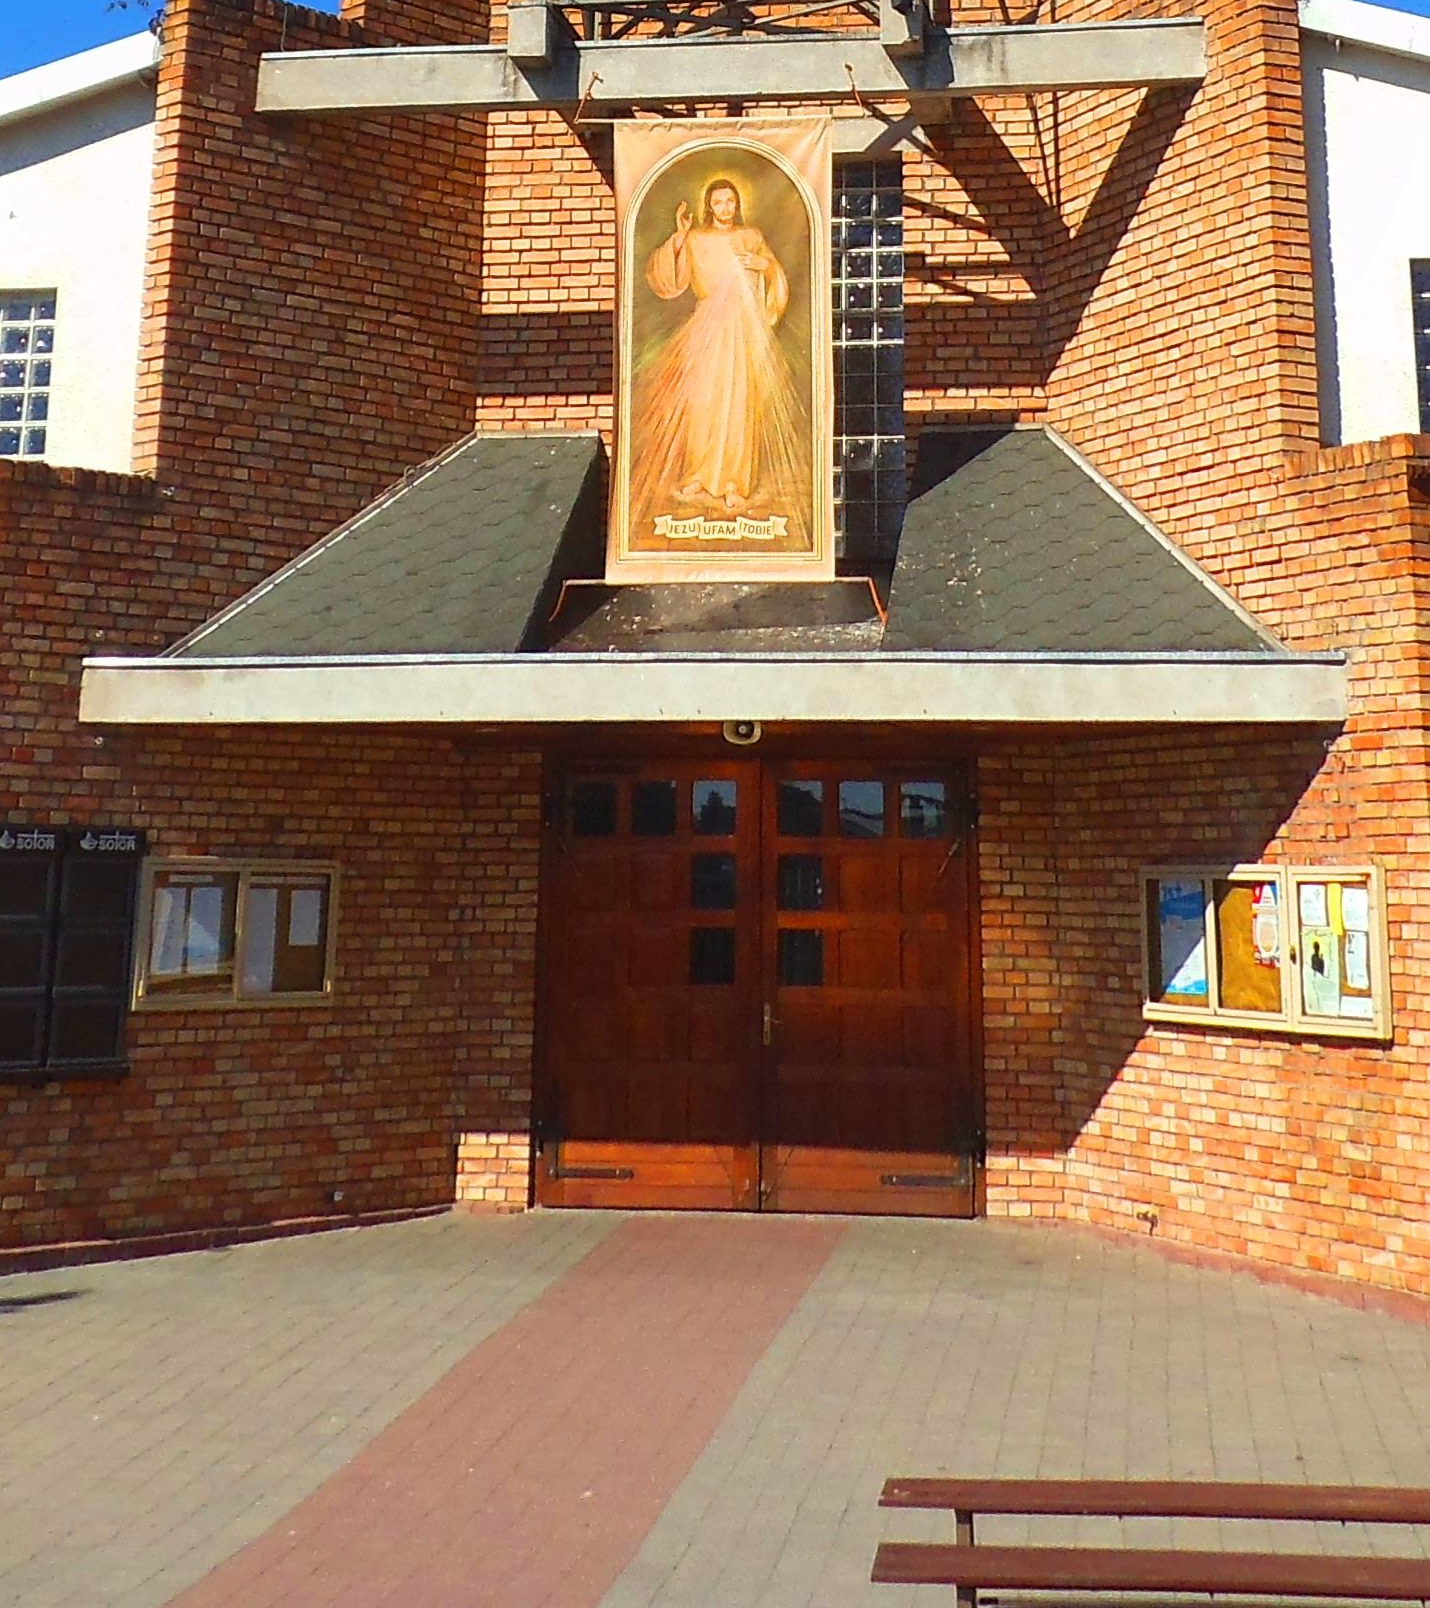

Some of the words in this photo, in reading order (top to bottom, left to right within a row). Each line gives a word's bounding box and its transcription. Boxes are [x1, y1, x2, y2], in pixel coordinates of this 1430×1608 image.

[669, 523, 695, 534] JEZU
[703, 525, 736, 535] UFAM
[743, 523, 772, 535] TOBIE
